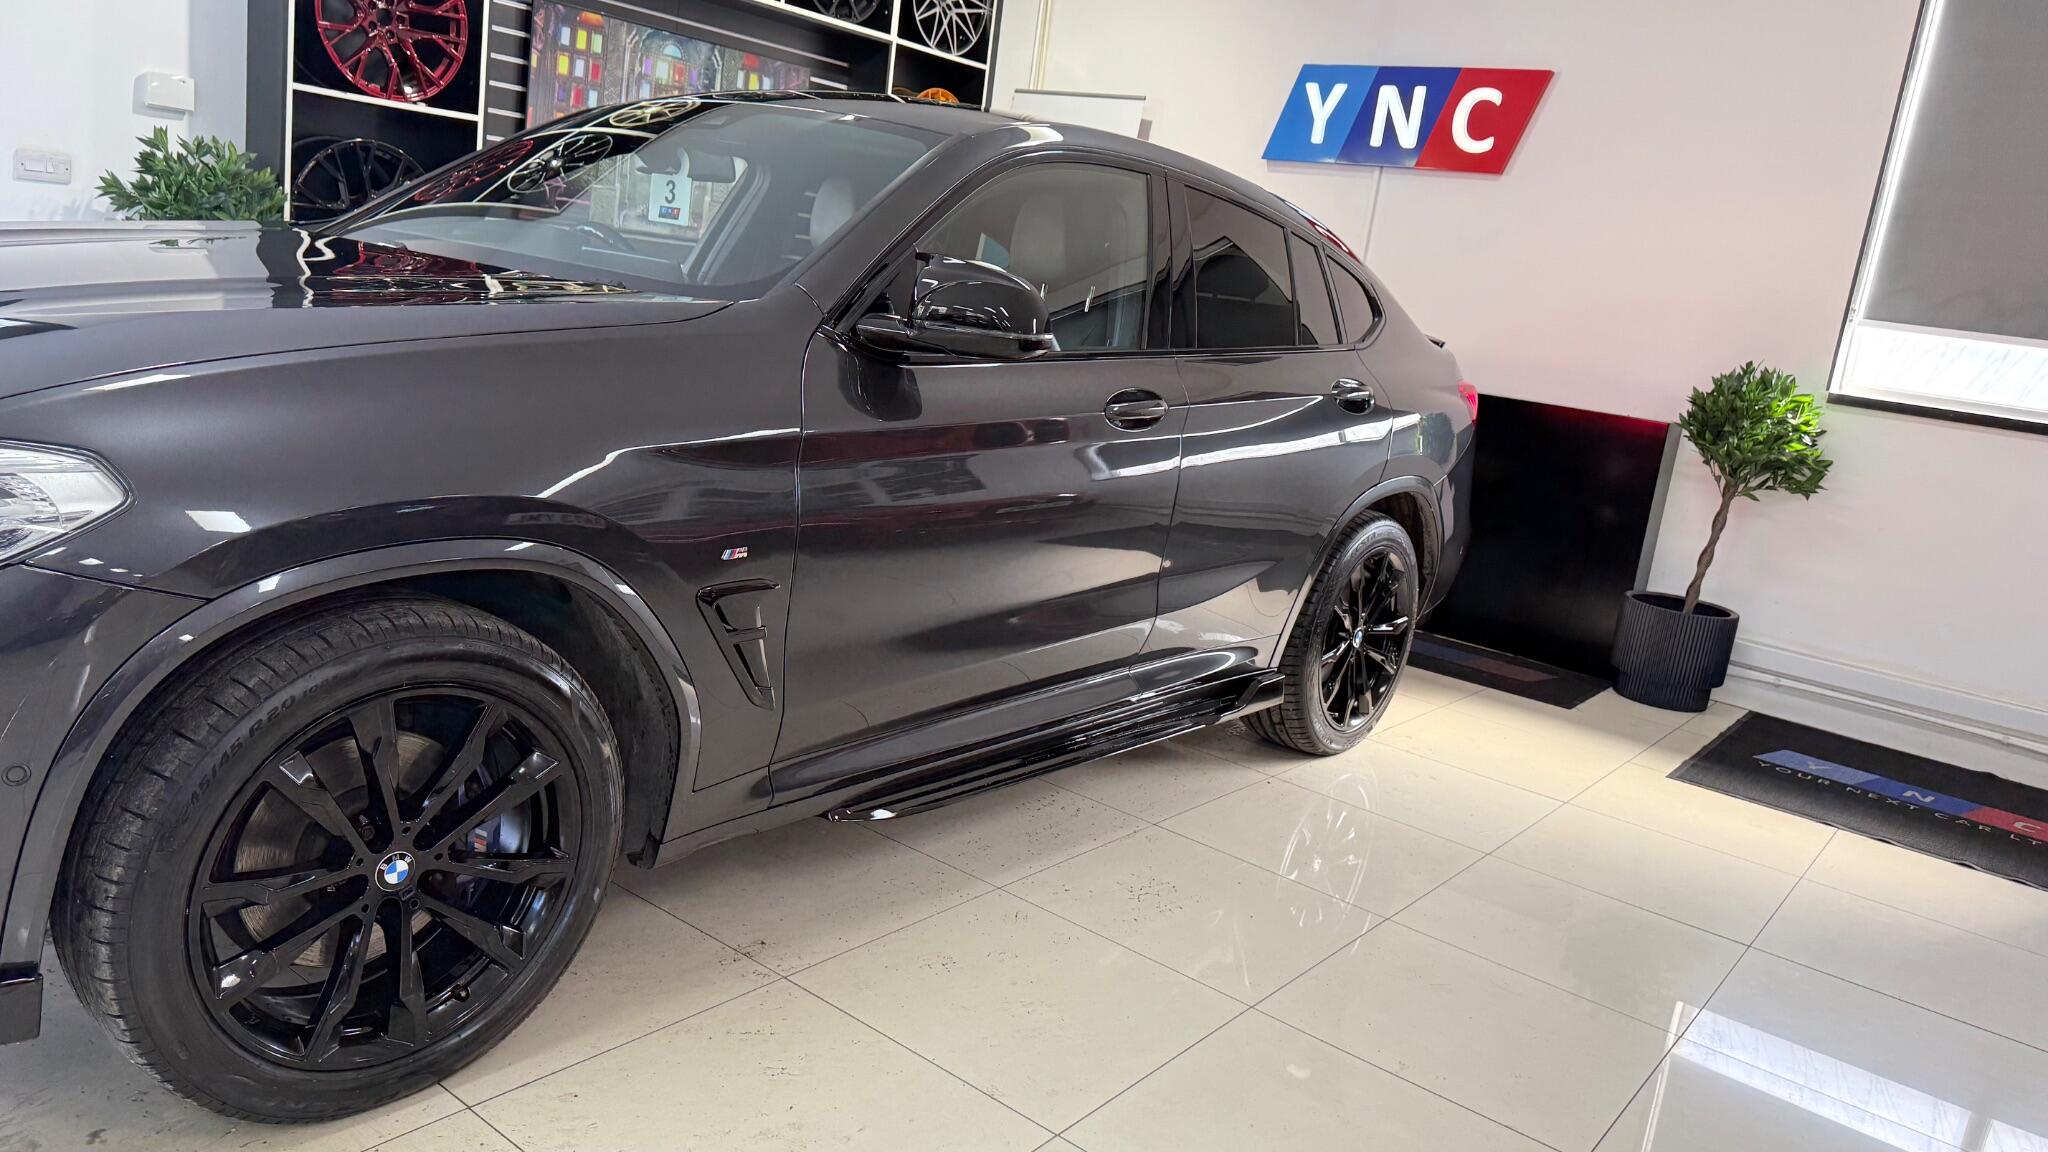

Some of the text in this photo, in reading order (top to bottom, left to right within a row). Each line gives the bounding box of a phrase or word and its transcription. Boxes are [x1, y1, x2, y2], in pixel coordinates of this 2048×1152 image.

[1305, 82, 1502, 154] YNC
[664, 179, 676, 204] 3
[1759, 761, 1830, 785] YOUR
[1846, 786, 1919, 810] NEXT
[1934, 812, 1992, 832] CAR
